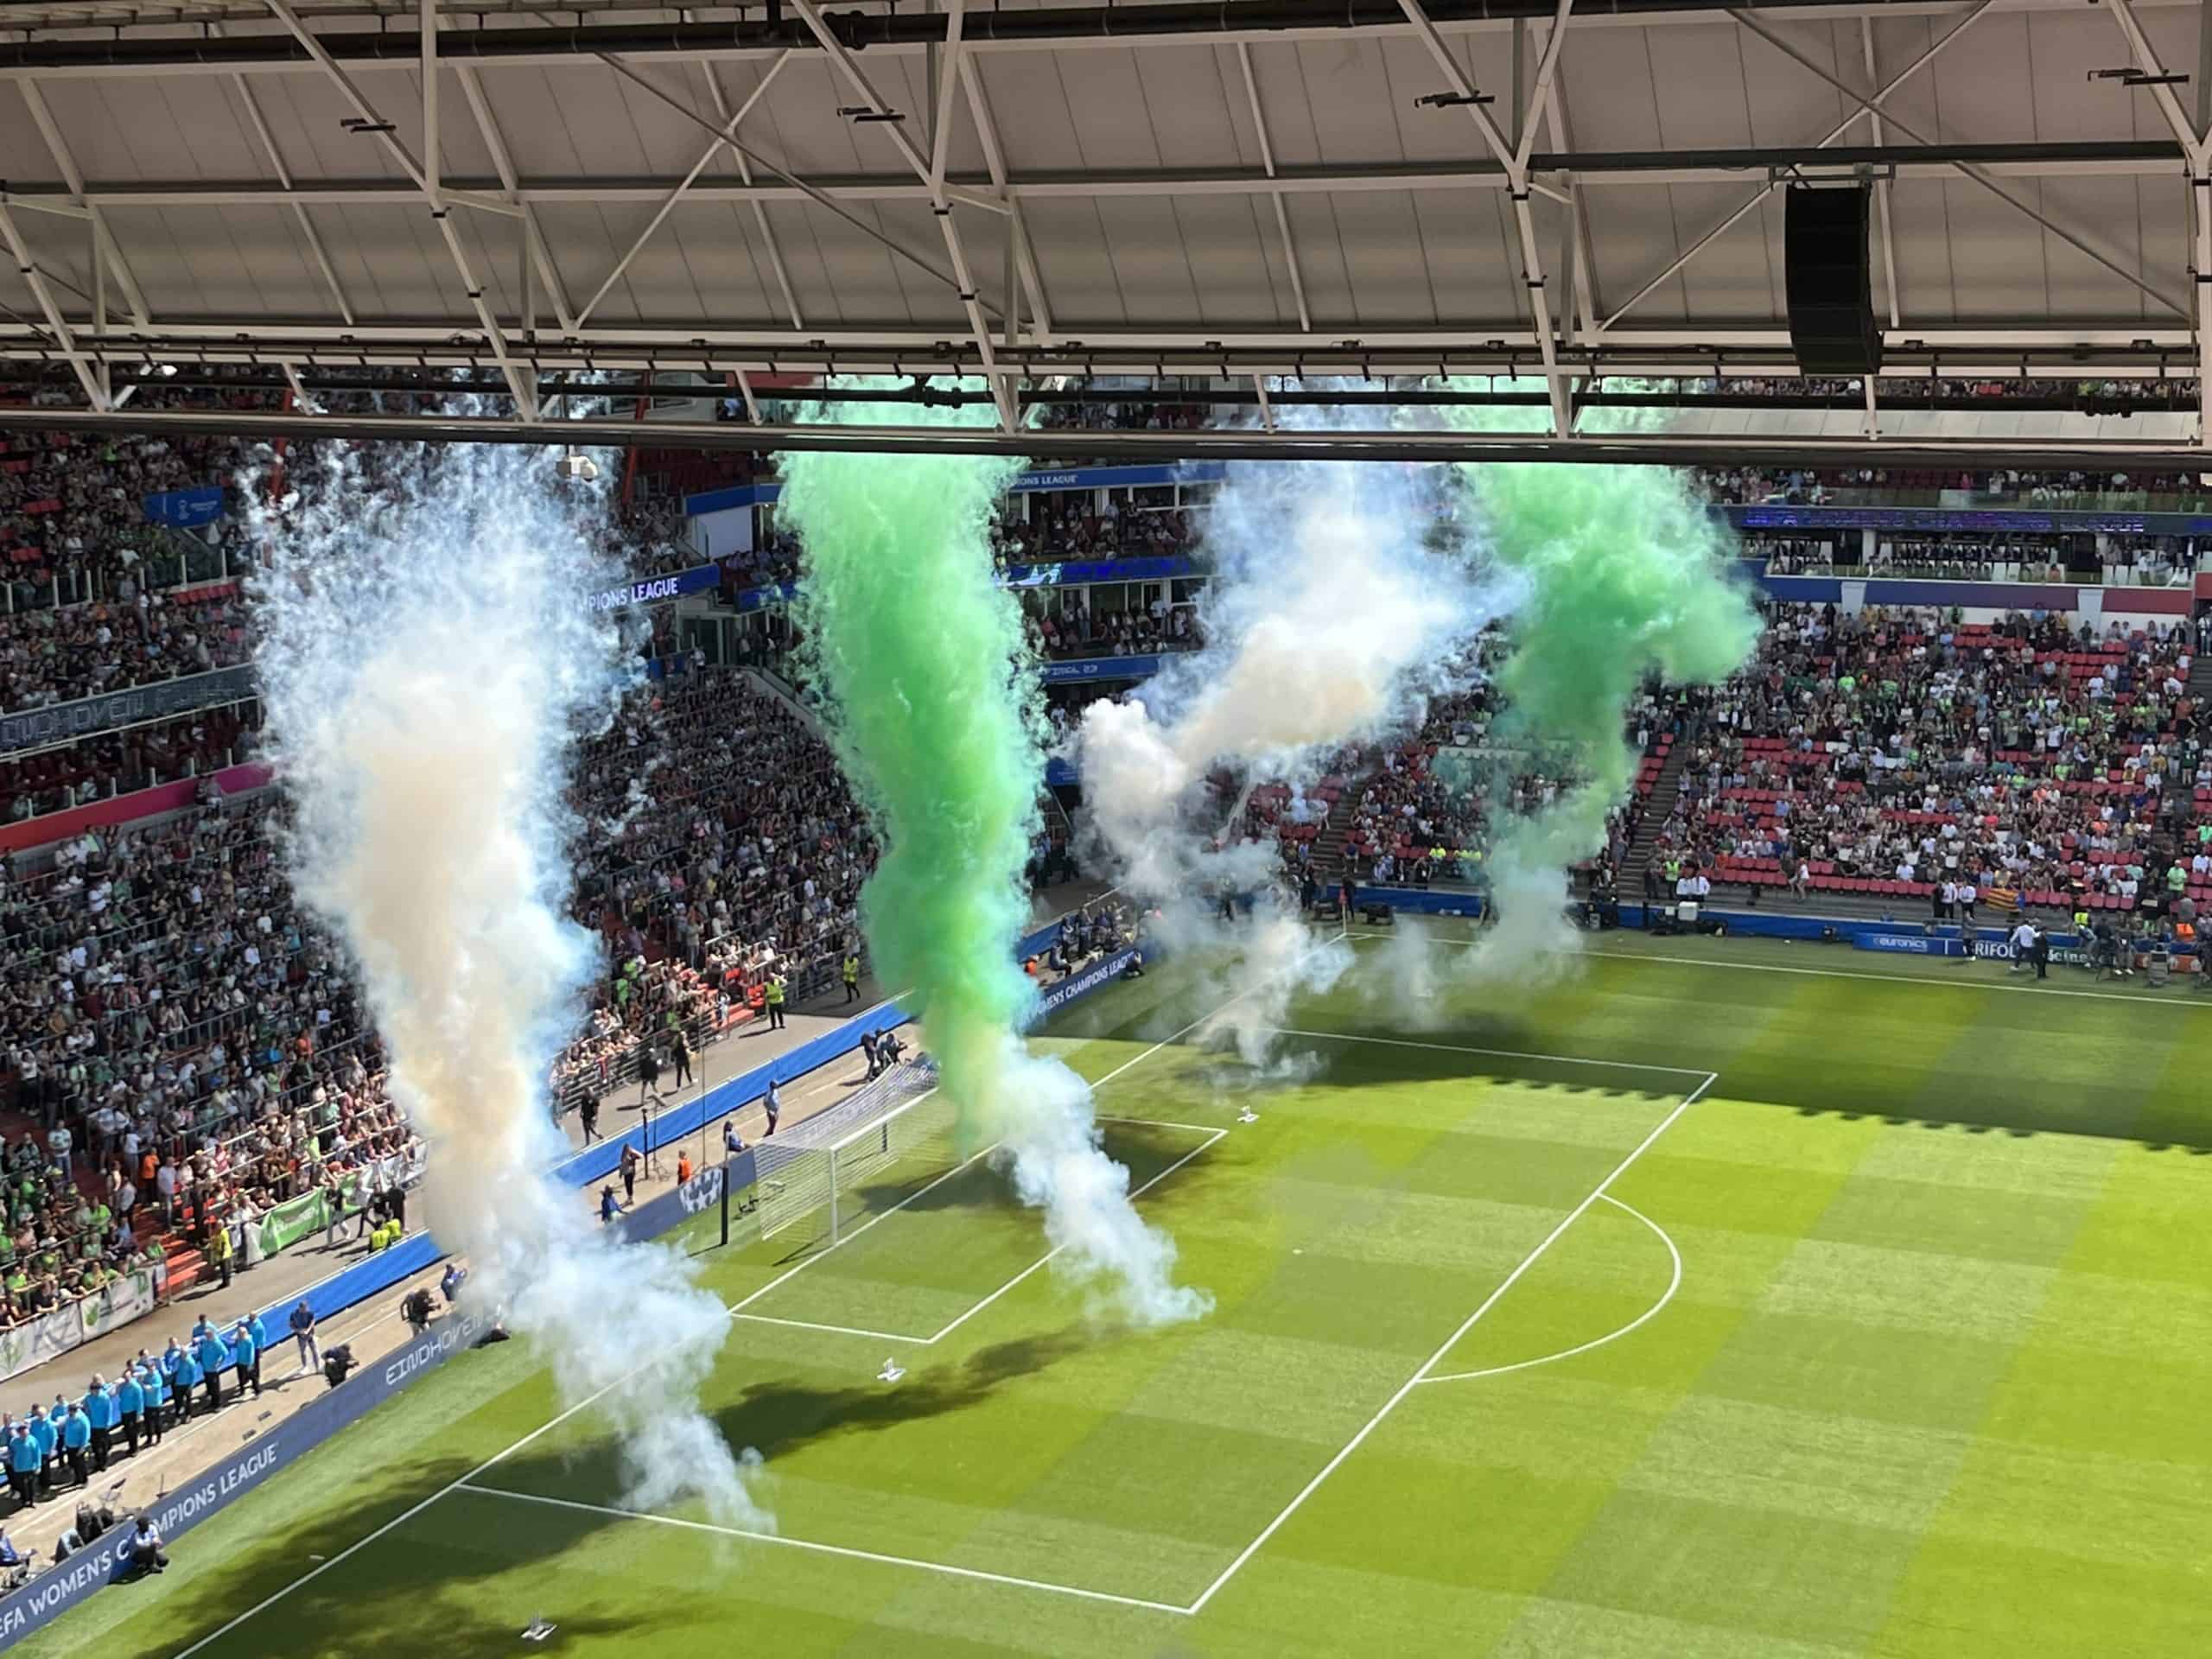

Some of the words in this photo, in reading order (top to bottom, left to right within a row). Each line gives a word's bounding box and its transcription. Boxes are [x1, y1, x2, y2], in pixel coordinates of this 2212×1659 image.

[1041, 474, 1078, 485] LEAGUE
[631, 576, 678, 603] LEAGUE
[1877, 937, 1928, 950] euronics
[1975, 943, 2018, 958] RIFOL
[1065, 966, 1109, 999] CHAMPIONS
[385, 1306, 486, 1385] EINDHOVEN
[28, 1550, 111, 1616] WOMEN'S
[116, 1483, 216, 1560] CMPIONS
[219, 1442, 279, 1495] LEAGUE
